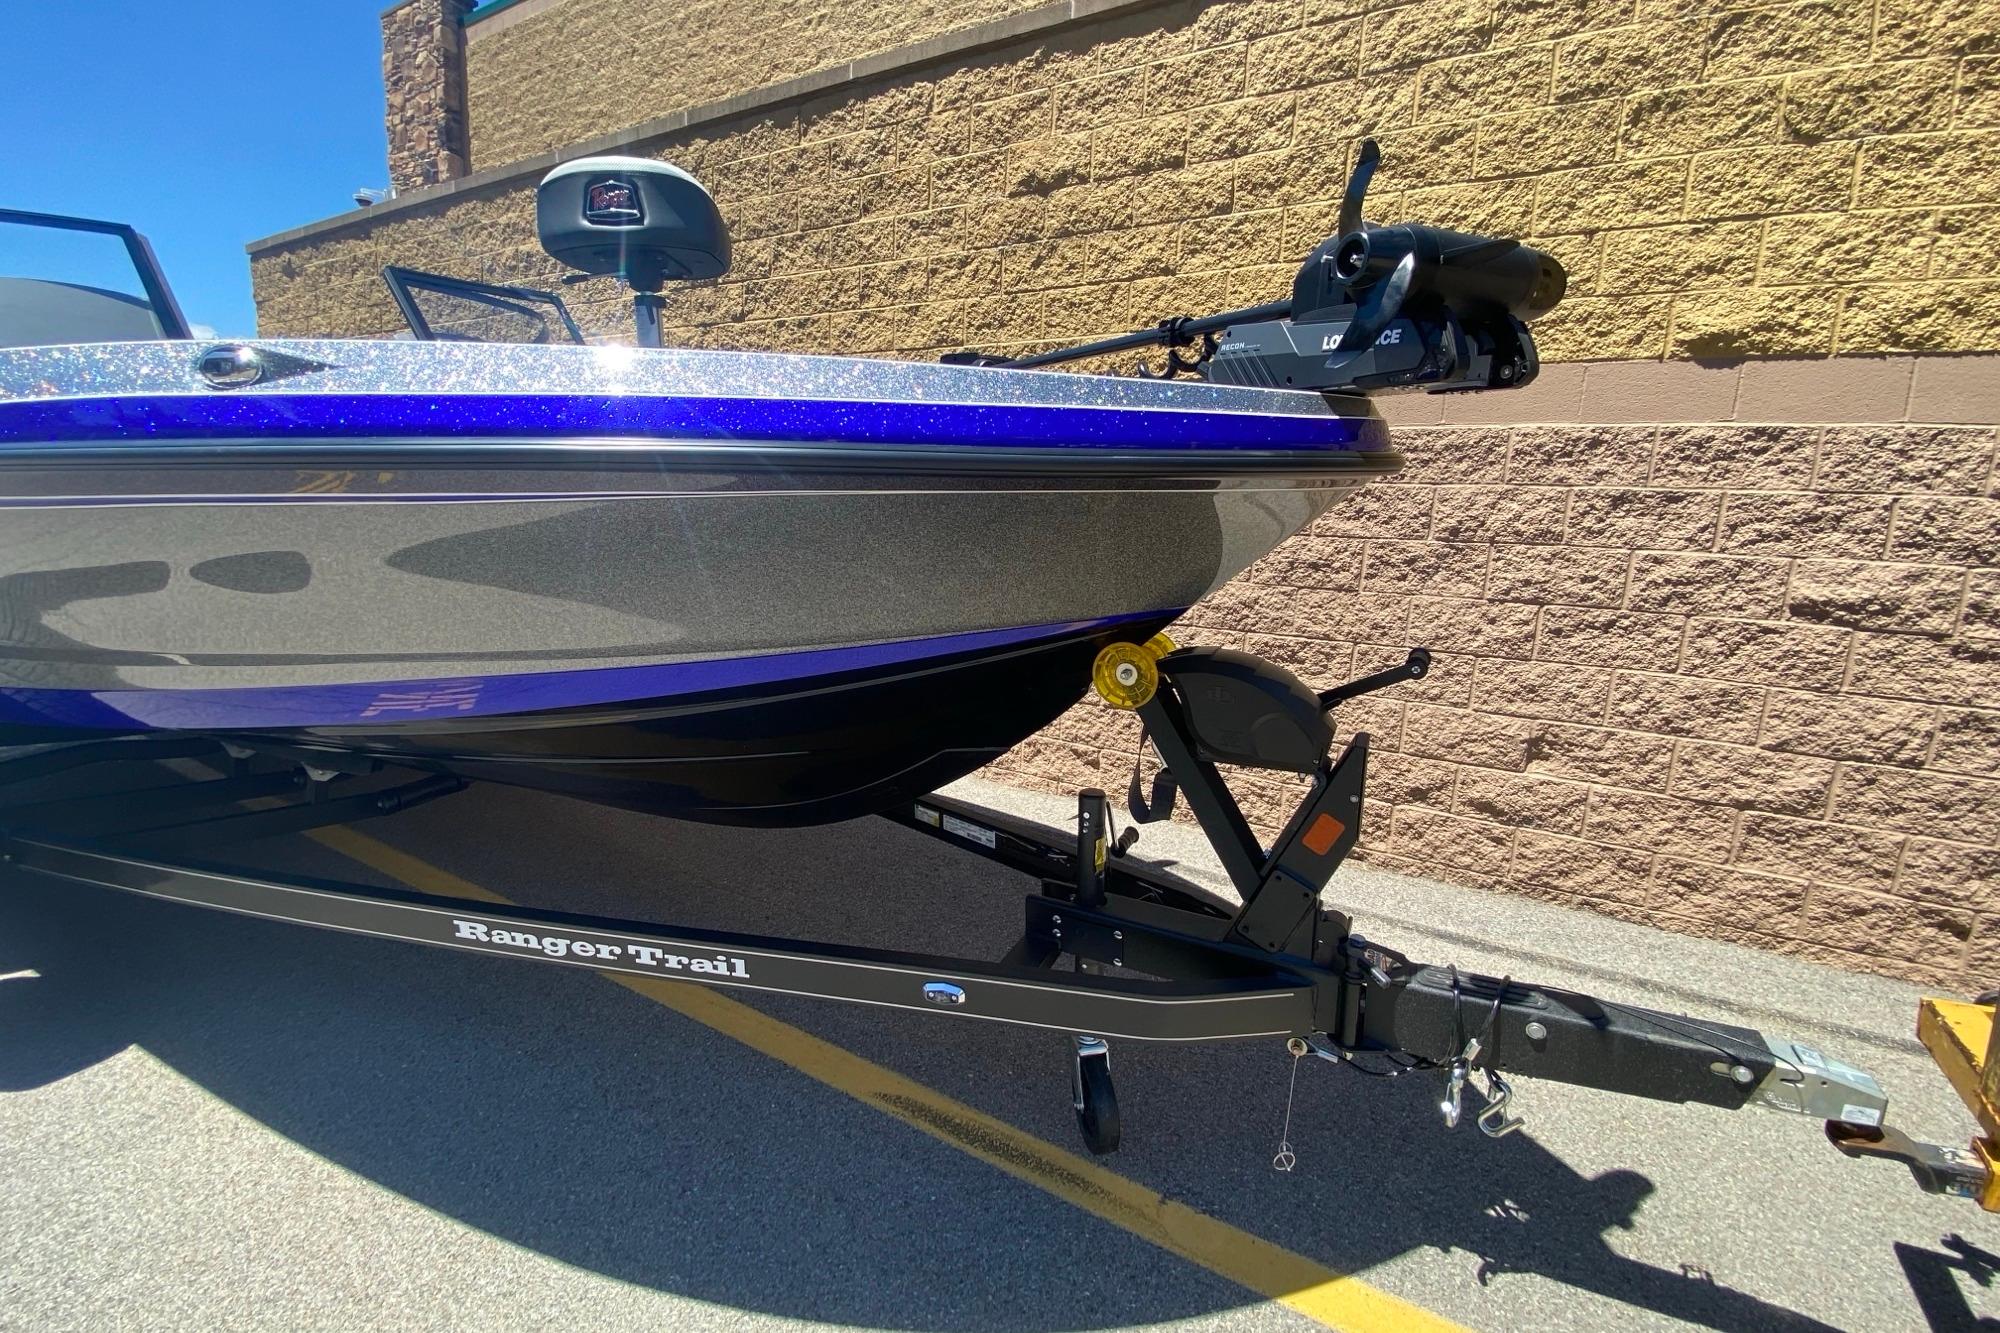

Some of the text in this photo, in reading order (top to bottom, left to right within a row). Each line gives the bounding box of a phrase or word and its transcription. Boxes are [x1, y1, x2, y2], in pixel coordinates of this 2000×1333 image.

[1220, 341, 1246, 352] RECON
[1321, 328, 1402, 351] LOCE
[452, 919, 750, 979] Ranger Trail
